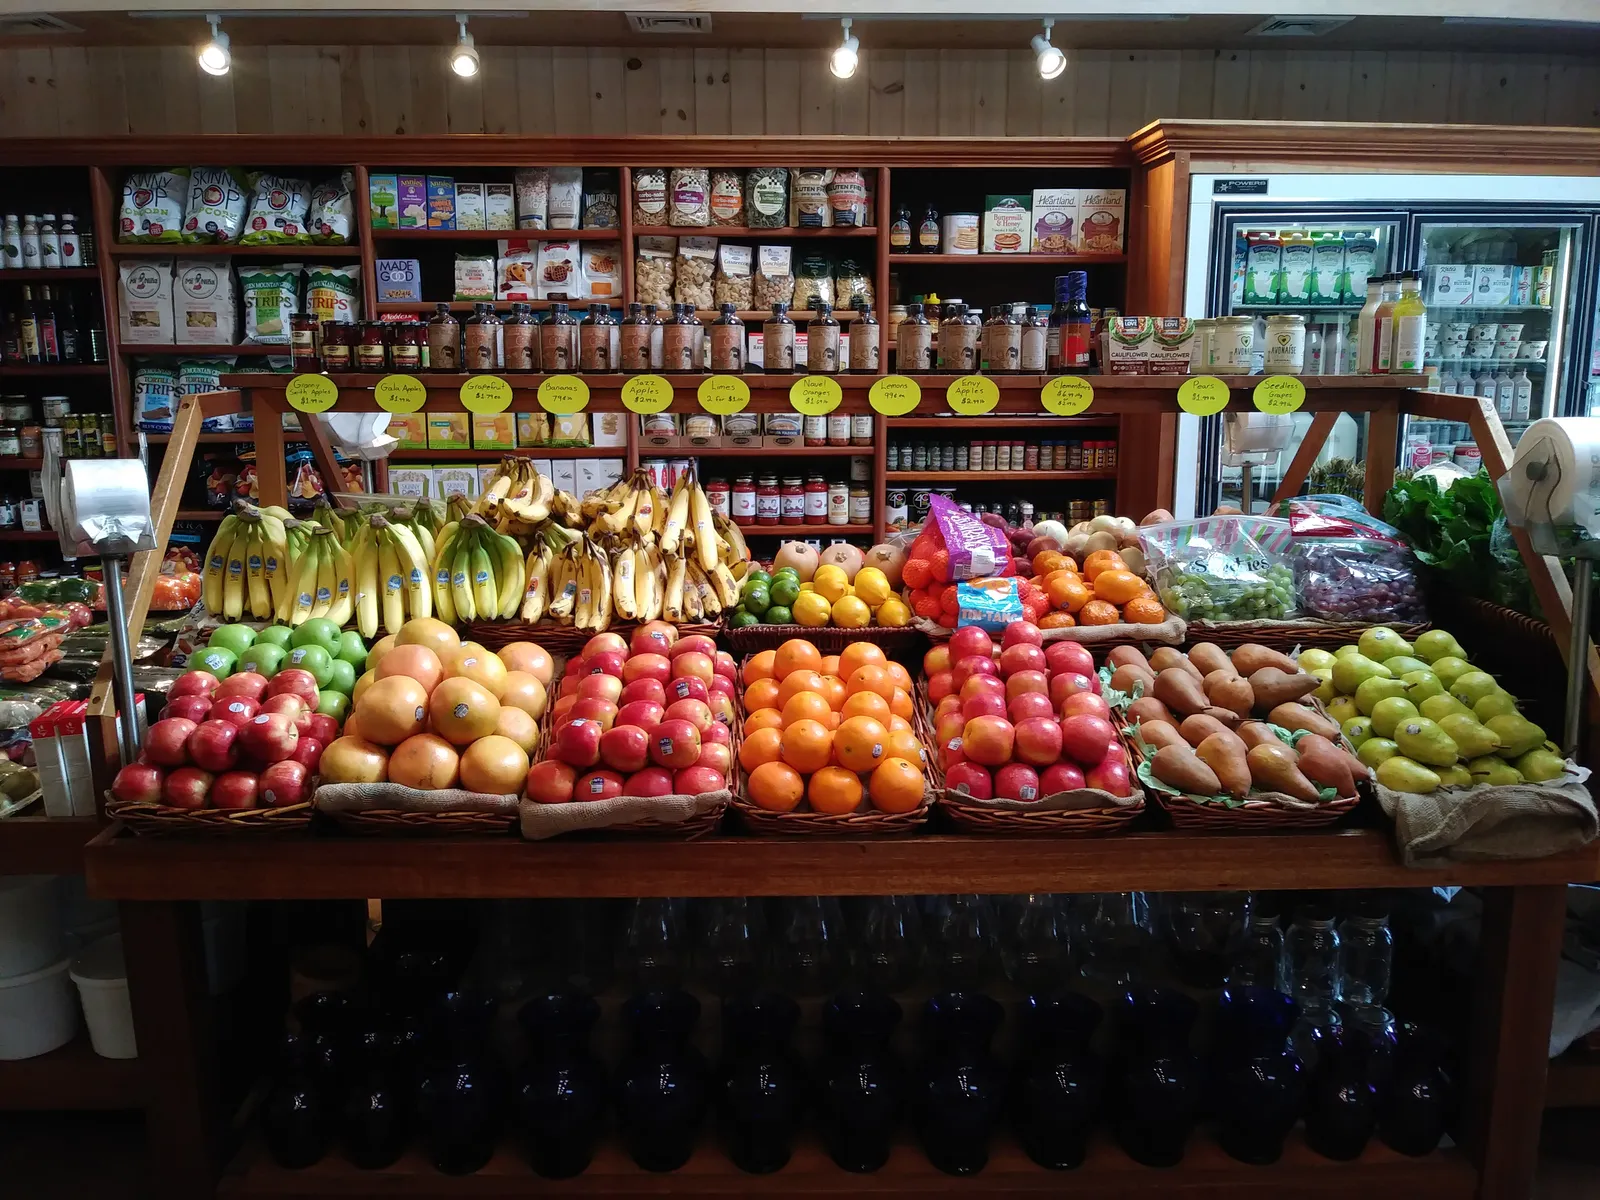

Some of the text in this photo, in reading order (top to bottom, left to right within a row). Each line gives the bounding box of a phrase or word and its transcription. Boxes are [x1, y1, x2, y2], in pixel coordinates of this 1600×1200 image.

[193, 185, 240, 209] POP
[1038, 195, 1075, 205] Heartland
[1084, 195, 1122, 205] Heartland
[380, 260, 412, 271] MADE
[381, 271, 414, 282] GOOD
[246, 296, 292, 308] STRIPS
[308, 298, 348, 310] STRIPS
[294, 380, 320, 390] Granny
[381, 383, 401, 392] Gala
[467, 382, 505, 391] Grapefruit
[546, 383, 578, 392] Bananas
[711, 380, 735, 390] Limes
[804, 379, 827, 388] Navel
[881, 382, 908, 390] Lemons
[962, 379, 981, 388] Envy
[1193, 380, 1215, 390] Pears
[1264, 380, 1298, 390] Seedless
[136, 383, 182, 397] STRIPS
[311, 388, 330, 396] Apples
[629, 387, 659, 396] Apples
[955, 387, 984, 396] Apples
[889, 494, 903, 508] 4C
[914, 494, 929, 508] 4C
